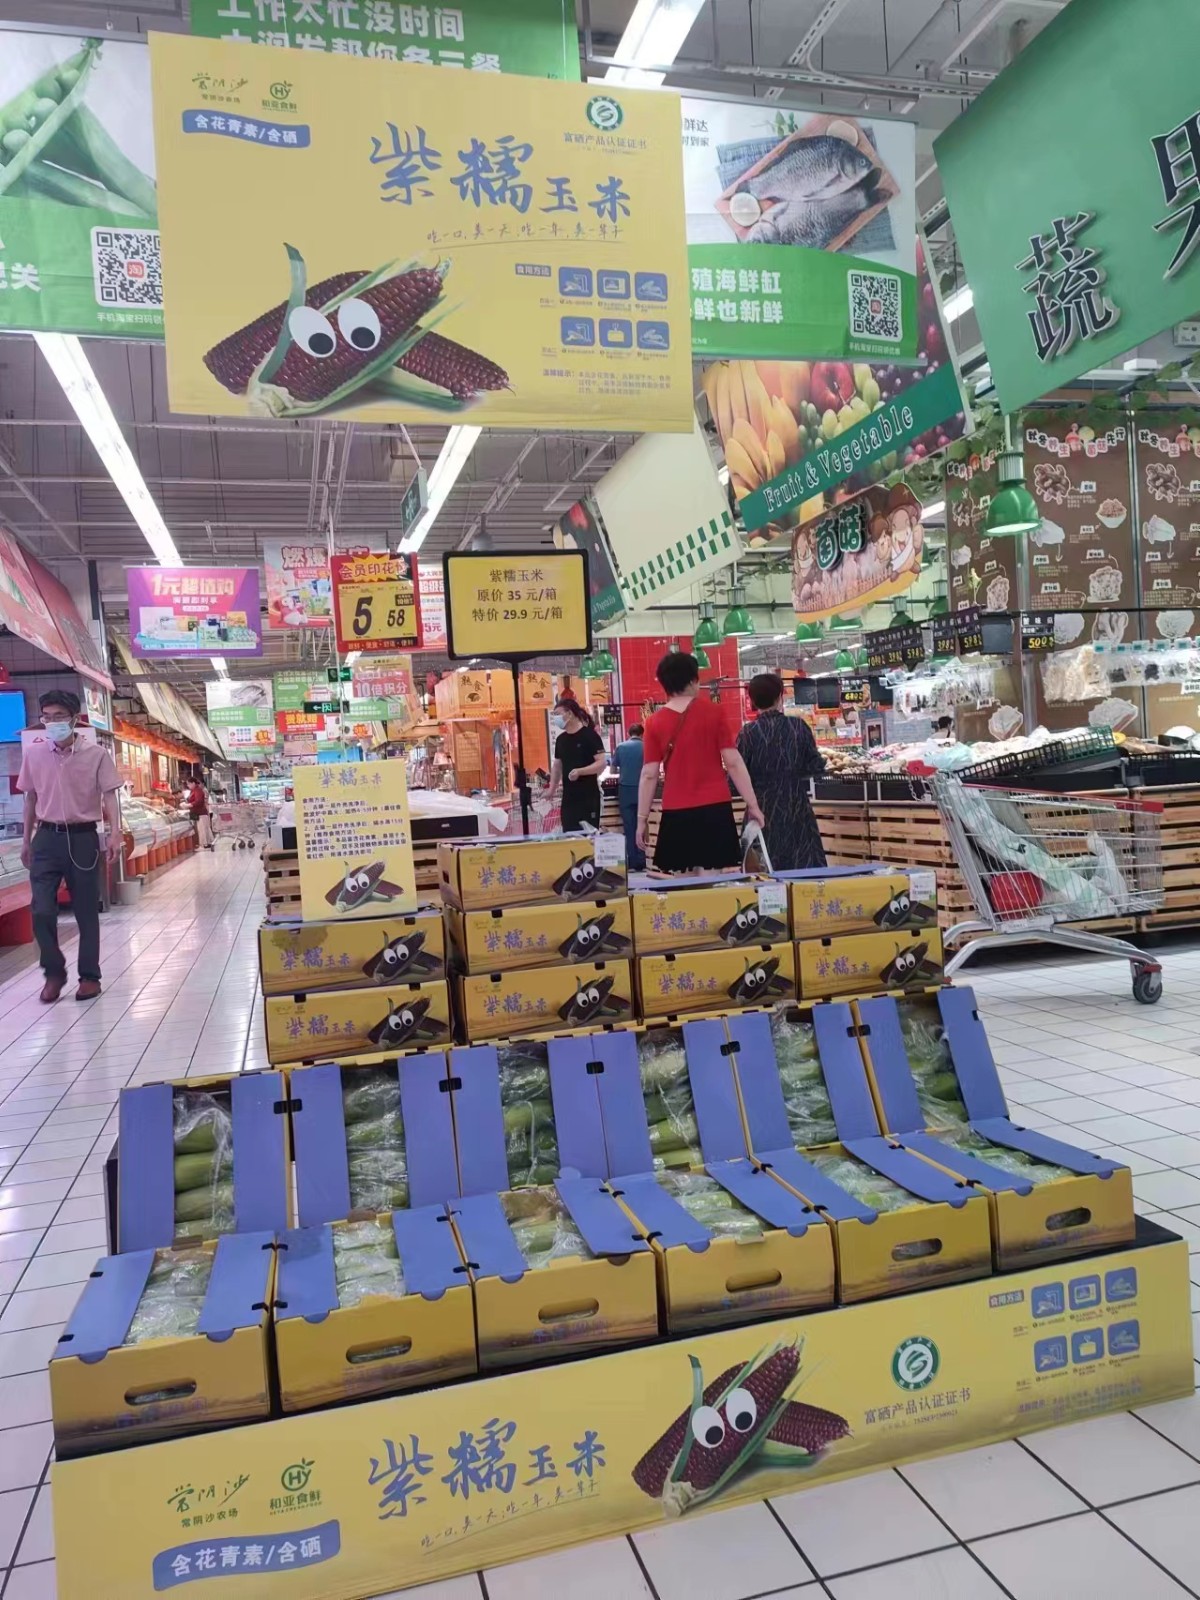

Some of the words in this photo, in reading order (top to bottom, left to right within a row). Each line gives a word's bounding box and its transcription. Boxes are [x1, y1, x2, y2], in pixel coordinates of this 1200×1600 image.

[195, 114, 297, 144] 含花青素/含硒
[369, 121, 631, 224] 紫糯玉米
[764, 475, 804, 513] Fruit
[817, 405, 914, 479] Vegetable
[489, 569, 544, 582] 紫糯玉米
[477, 589, 503, 602] 原价
[507, 590, 521, 600] 35
[526, 588, 557, 601] 元/箱
[472, 608, 500, 622] 特价
[503, 609, 527, 620] 29.9
[533, 606, 563, 620] 元/箱
[865, 1387, 971, 1424] 富硒产品认证证书
[368, 1418, 606, 1520] 紫糯玉米
[181, 1508, 239, 1528] 常阴沙农场
[171, 1536, 322, 1577] 含花青素/含硒
